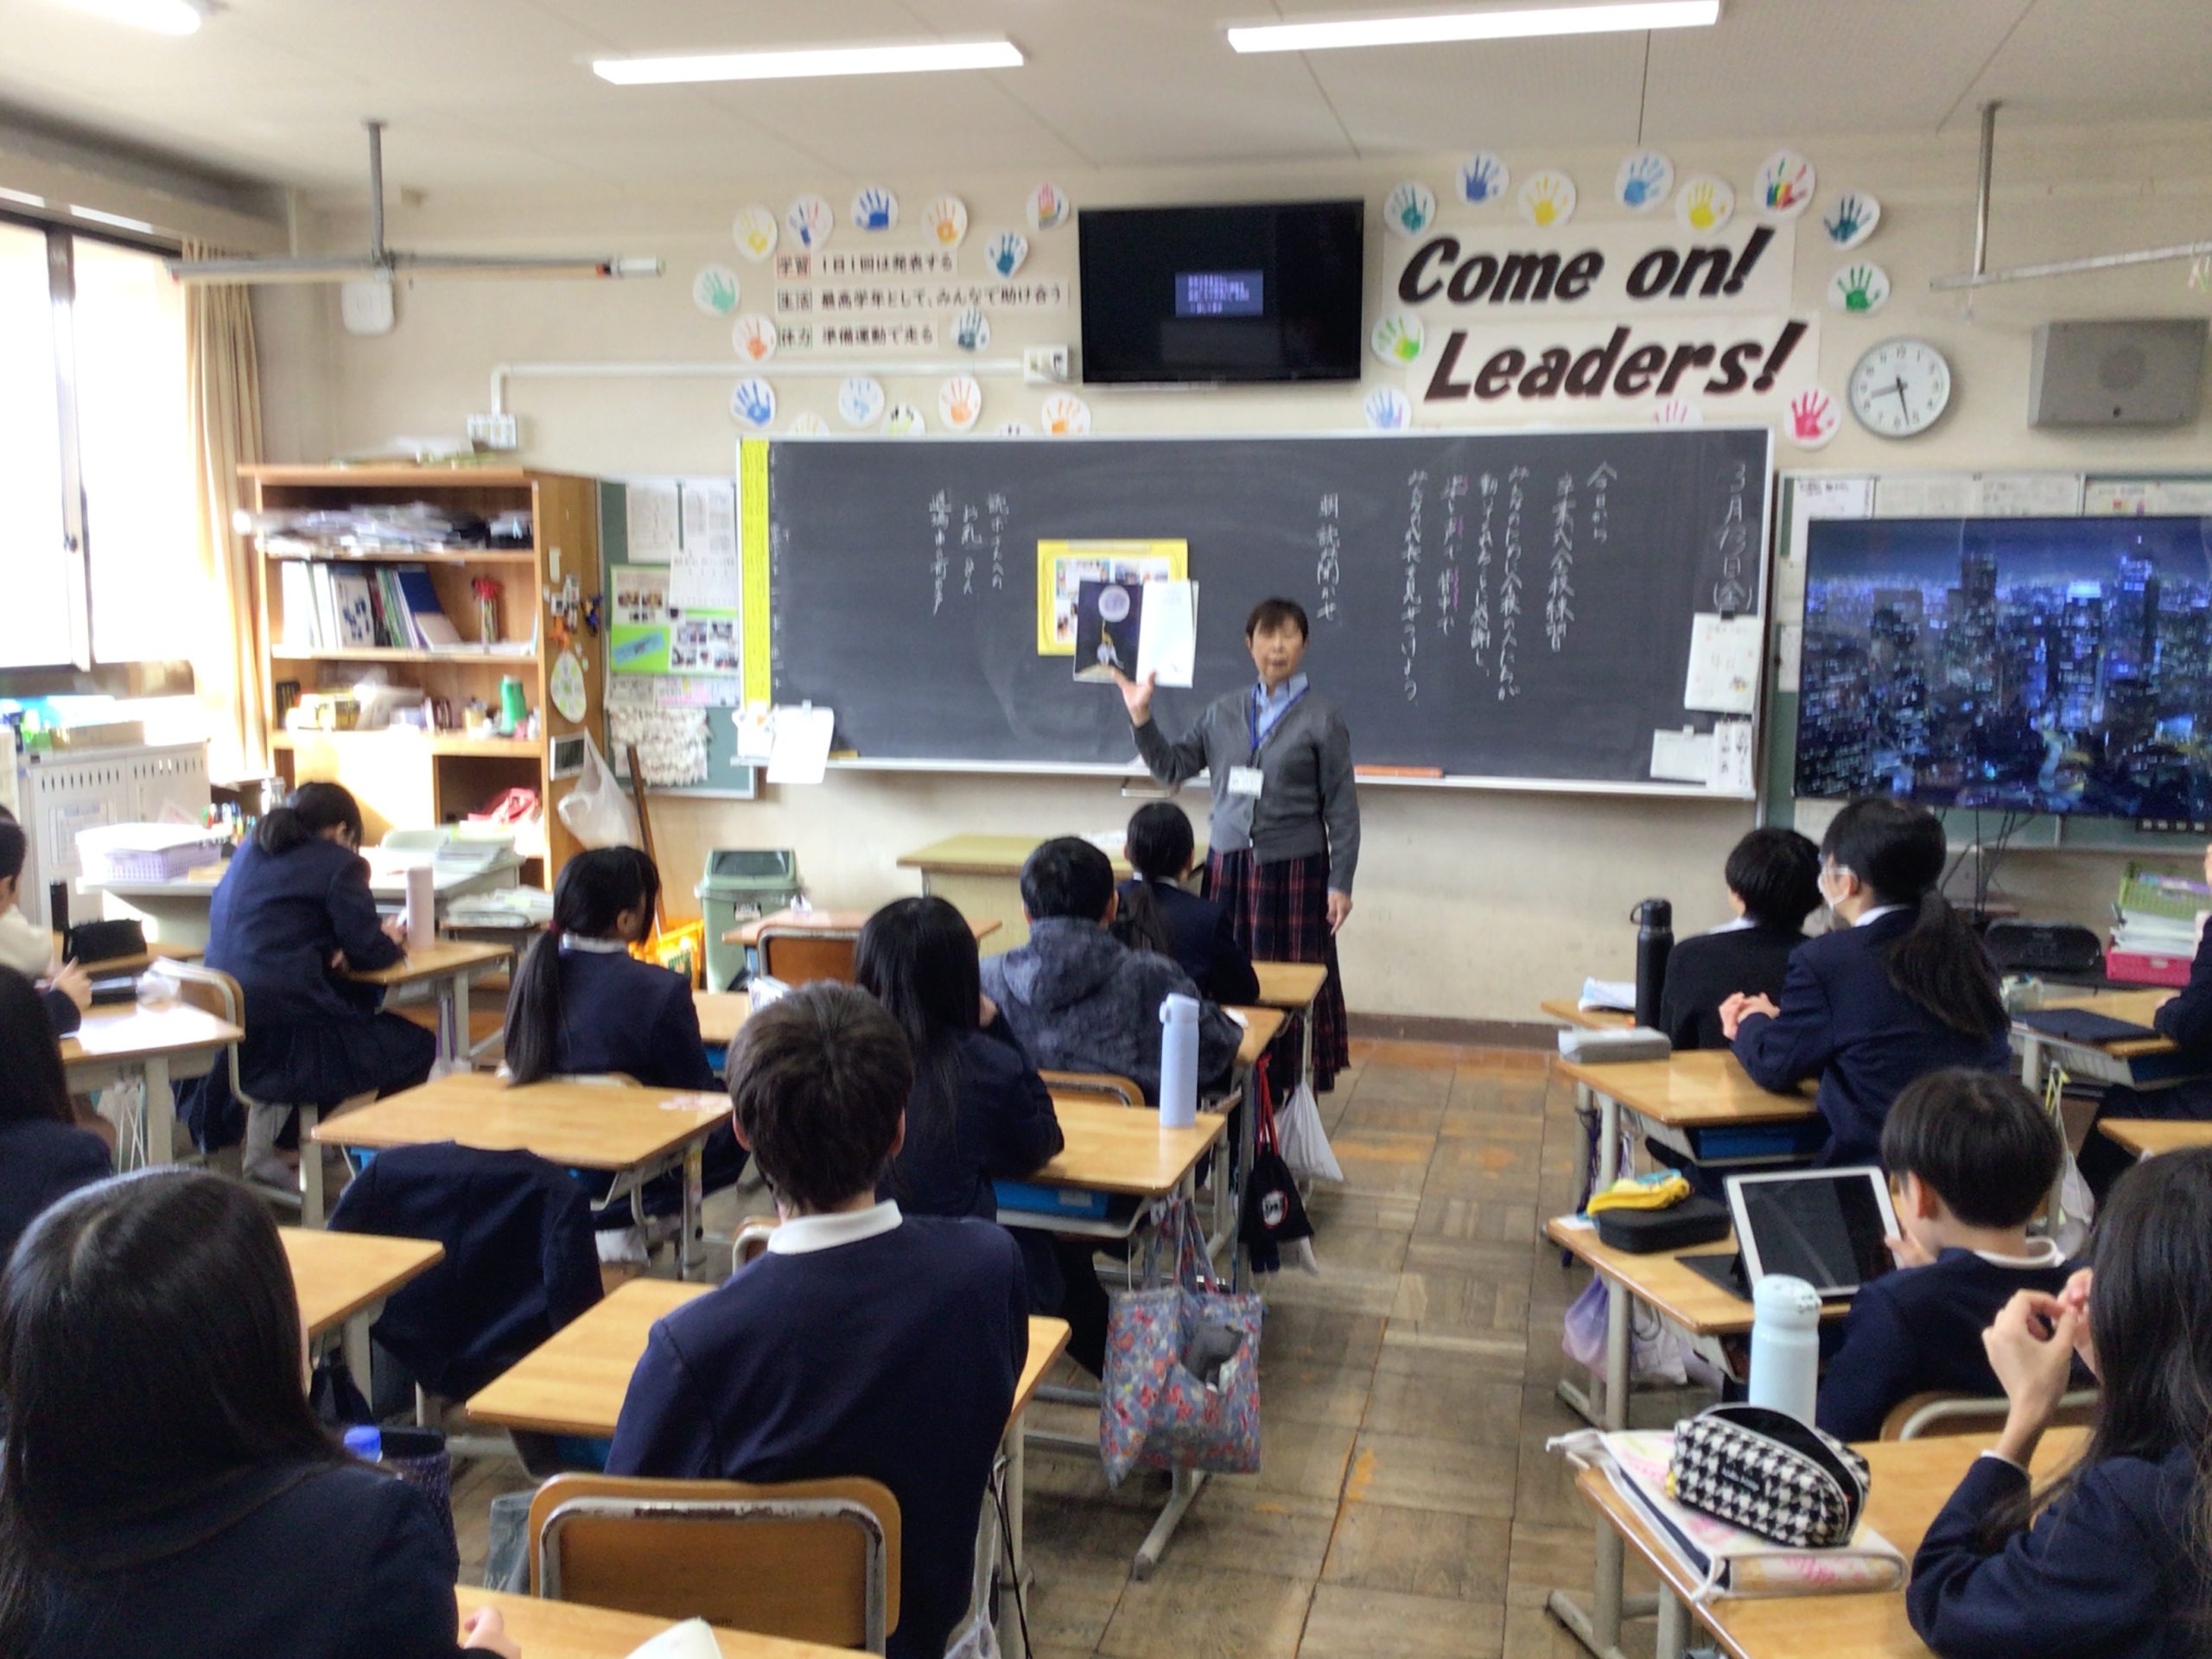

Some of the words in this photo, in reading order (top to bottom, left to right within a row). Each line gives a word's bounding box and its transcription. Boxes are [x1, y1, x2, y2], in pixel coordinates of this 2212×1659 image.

[779, 254, 810, 275] 学習
[823, 253, 952, 275] 1日1回は発表する
[1398, 237, 1605, 304] Come
[1625, 225, 1776, 300] on!
[779, 289, 812, 311] 生活
[781, 330, 812, 350] 体力
[823, 322, 933, 346] 準備運動で走る
[1424, 321, 1808, 403] Leaders!
